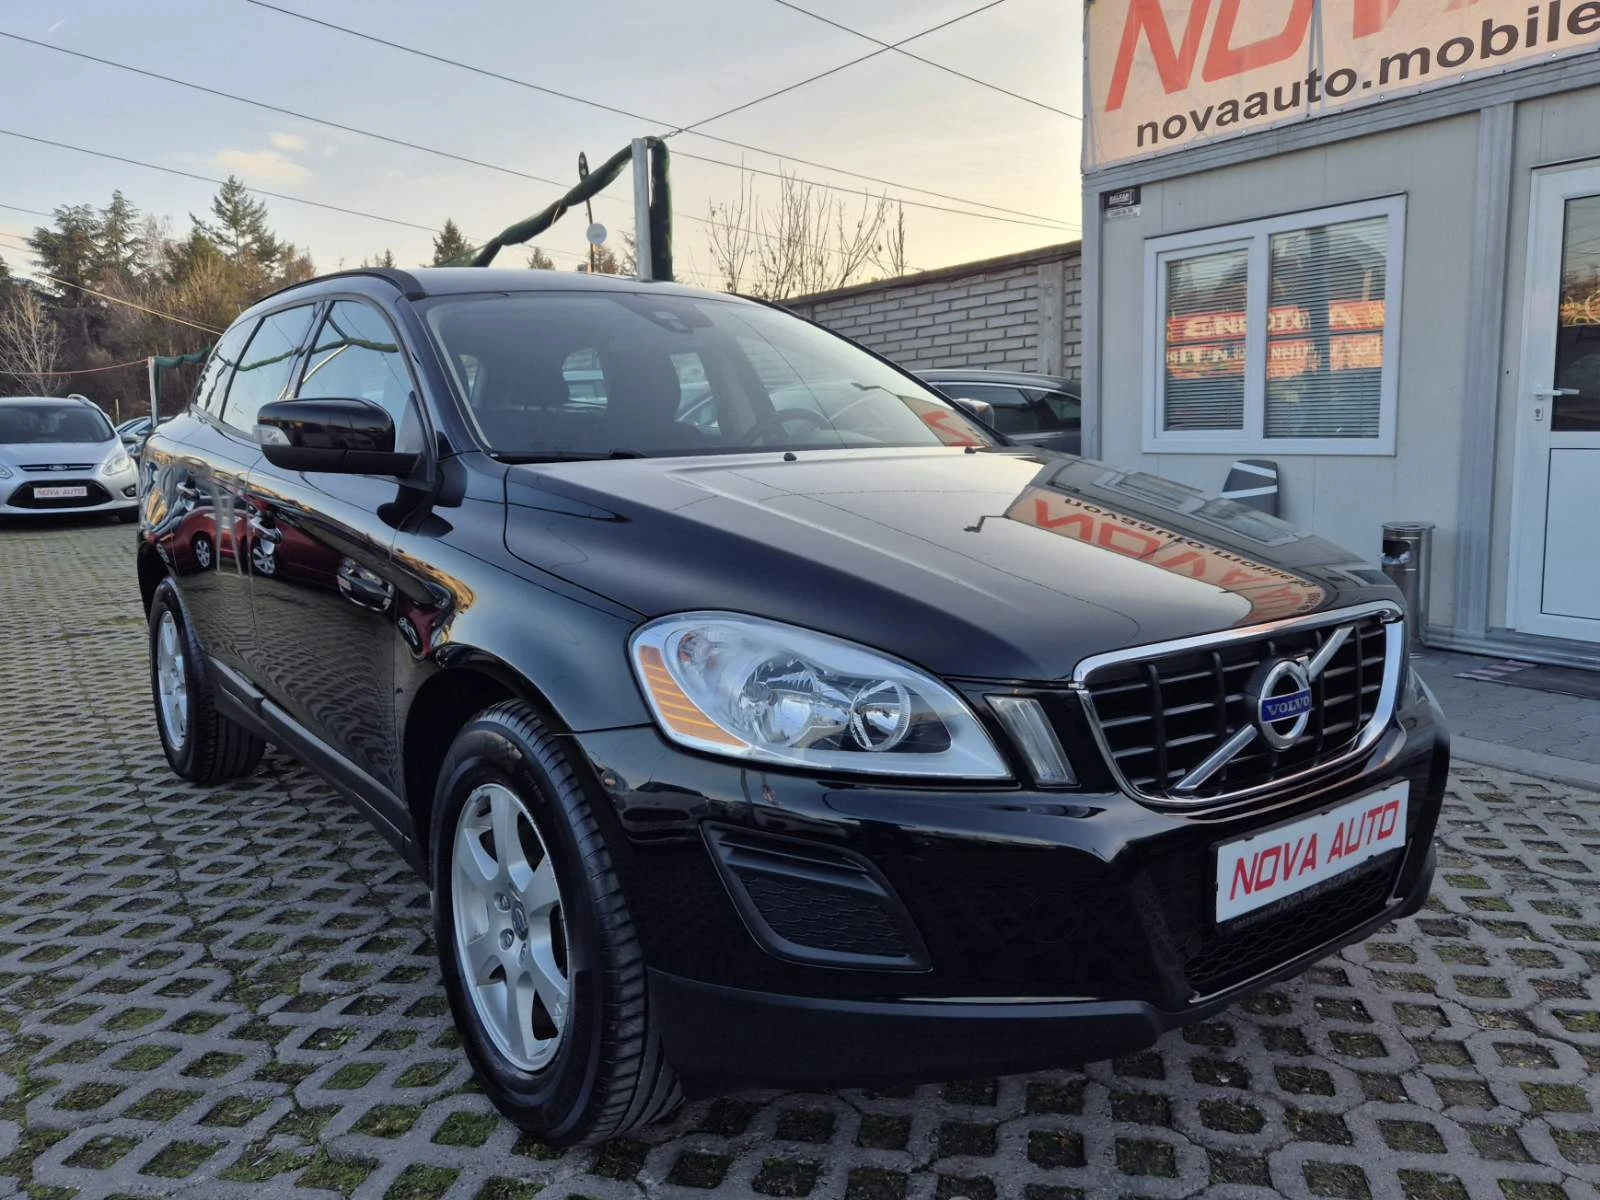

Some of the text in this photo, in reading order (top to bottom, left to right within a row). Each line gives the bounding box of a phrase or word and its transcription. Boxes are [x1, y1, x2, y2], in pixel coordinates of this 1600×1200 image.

[36, 488, 60, 497] NOVA
[1266, 694, 1311, 717] VOLVO
[1228, 832, 1318, 901] NOVA
[1326, 799, 1400, 864] AUTO
